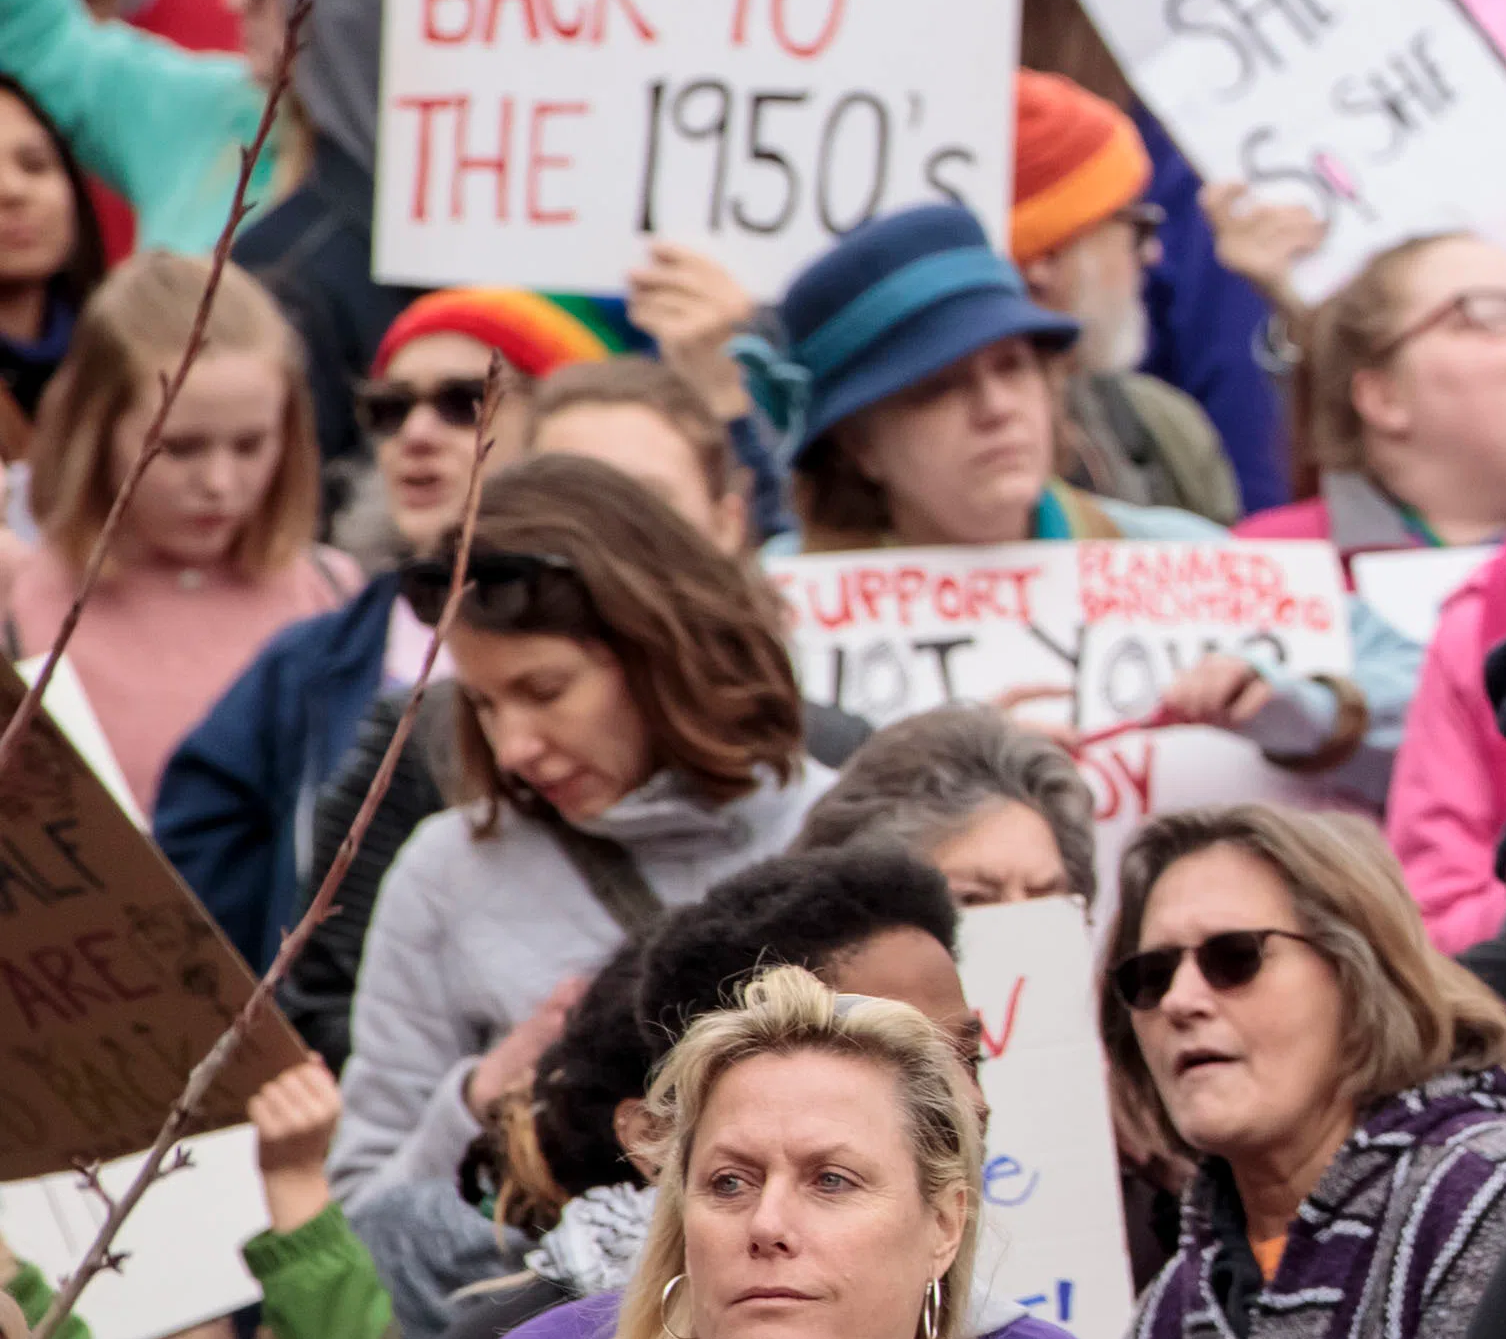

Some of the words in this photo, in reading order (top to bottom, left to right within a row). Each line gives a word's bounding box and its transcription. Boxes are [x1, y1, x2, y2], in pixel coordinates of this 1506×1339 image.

[391, 93, 594, 225] THE
[634, 77, 980, 239] 1950's
[1333, 29, 1460, 163] SHE
[10, 923, 162, 1033] ARE
